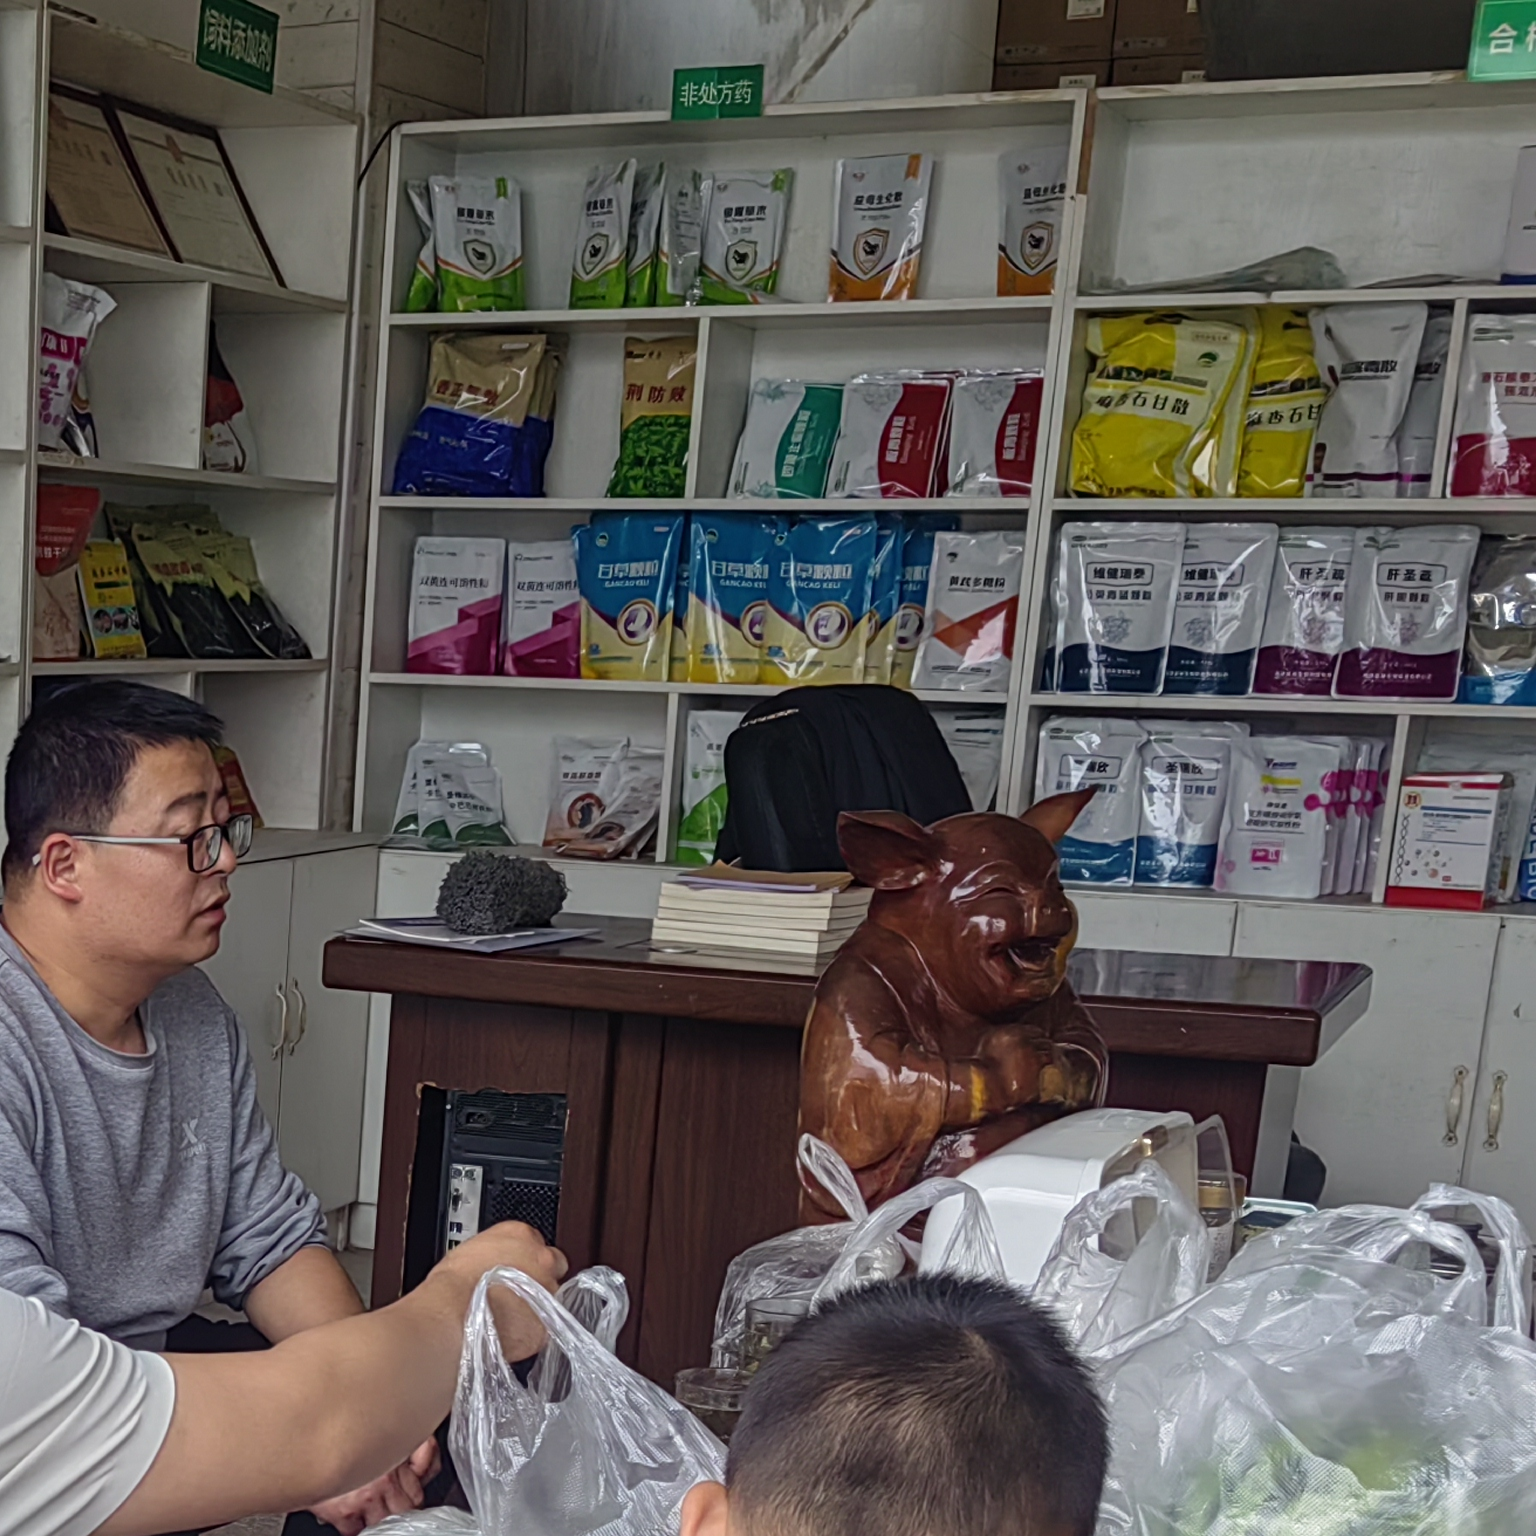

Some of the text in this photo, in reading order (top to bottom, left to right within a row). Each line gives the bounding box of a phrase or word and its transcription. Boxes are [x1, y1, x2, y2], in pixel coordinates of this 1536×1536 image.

[203, 6, 272, 72] 饲料添加剂
[679, 79, 754, 107] 非处方药
[711, 560, 768, 580] 甘草颗
[1093, 566, 1146, 580] 维健瑞泰
